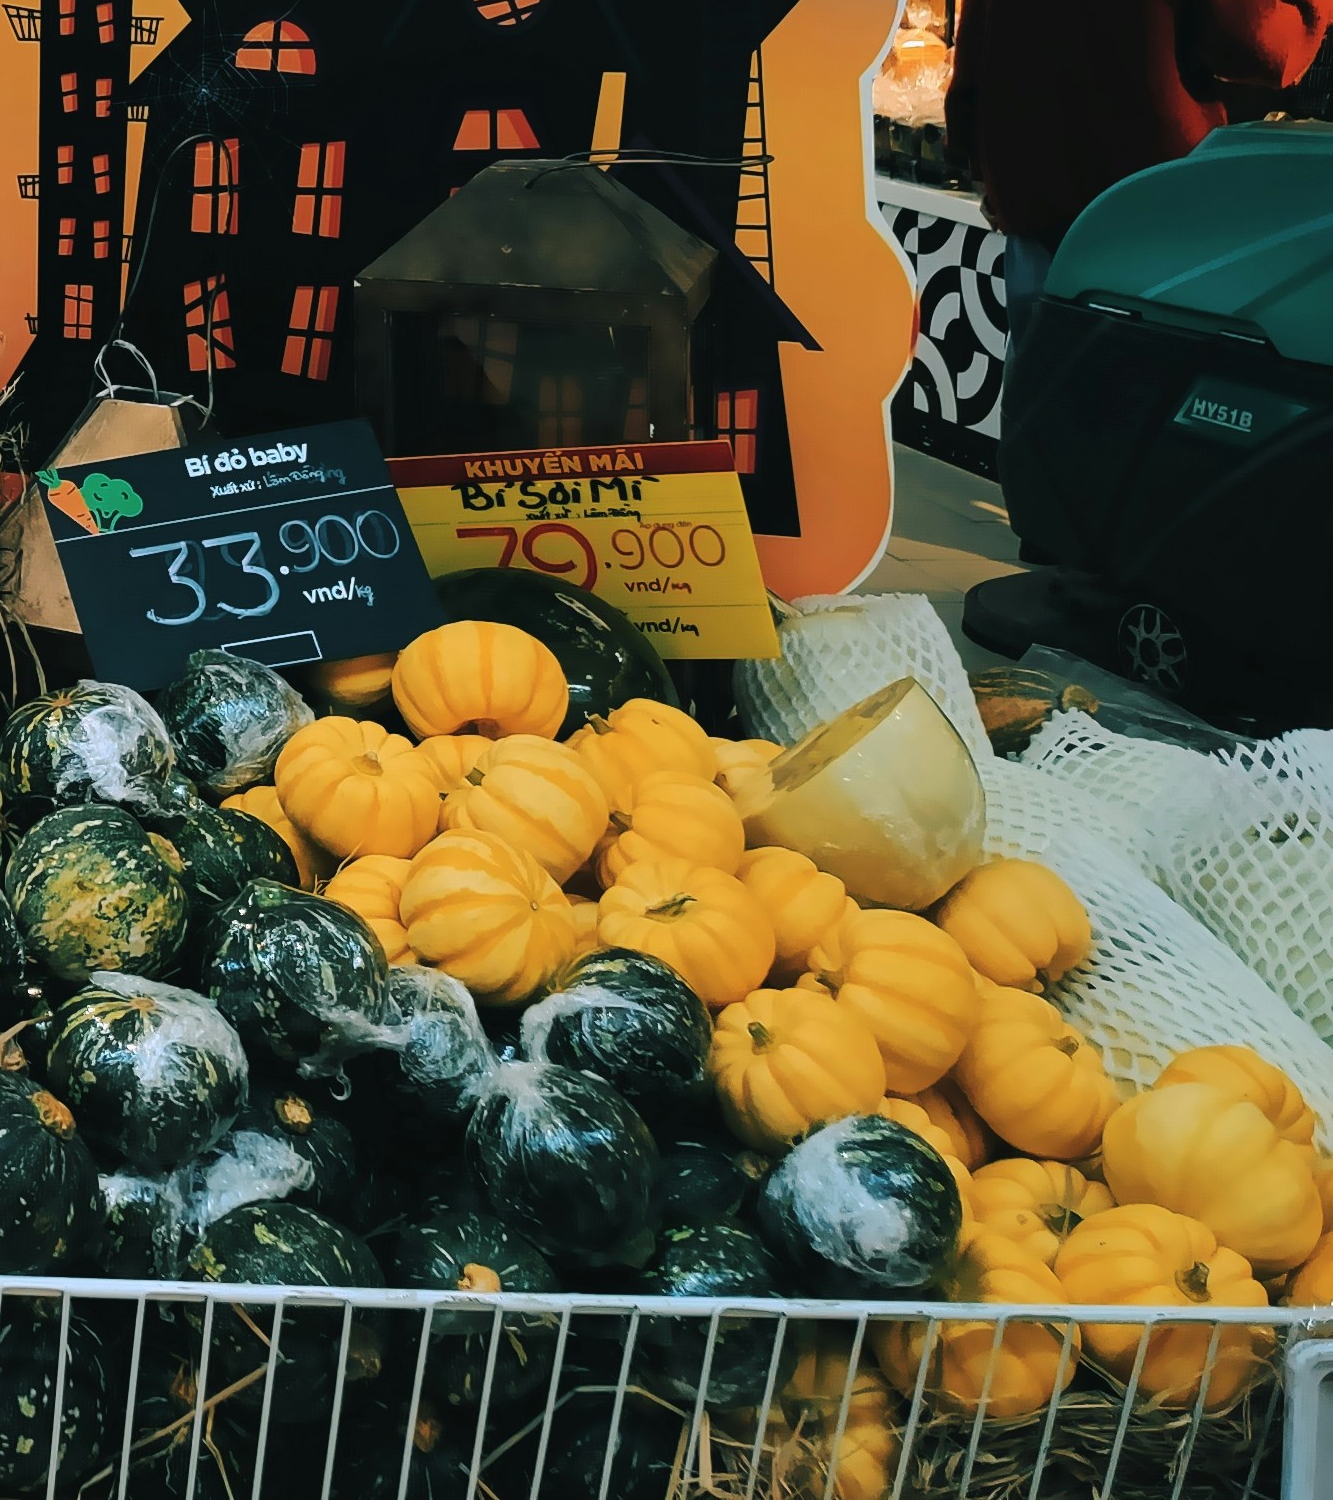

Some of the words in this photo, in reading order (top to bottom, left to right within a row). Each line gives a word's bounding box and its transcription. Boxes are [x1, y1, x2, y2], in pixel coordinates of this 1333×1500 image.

[184, 453, 210, 479] Bí
[212, 445, 247, 474] đỏ
[249, 439, 309, 471] baby
[464, 449, 584, 479] KHUYẾN
[589, 450, 645, 473] MÃI
[129, 508, 402, 625] 33.900
[455, 522, 727, 593] 79.900
